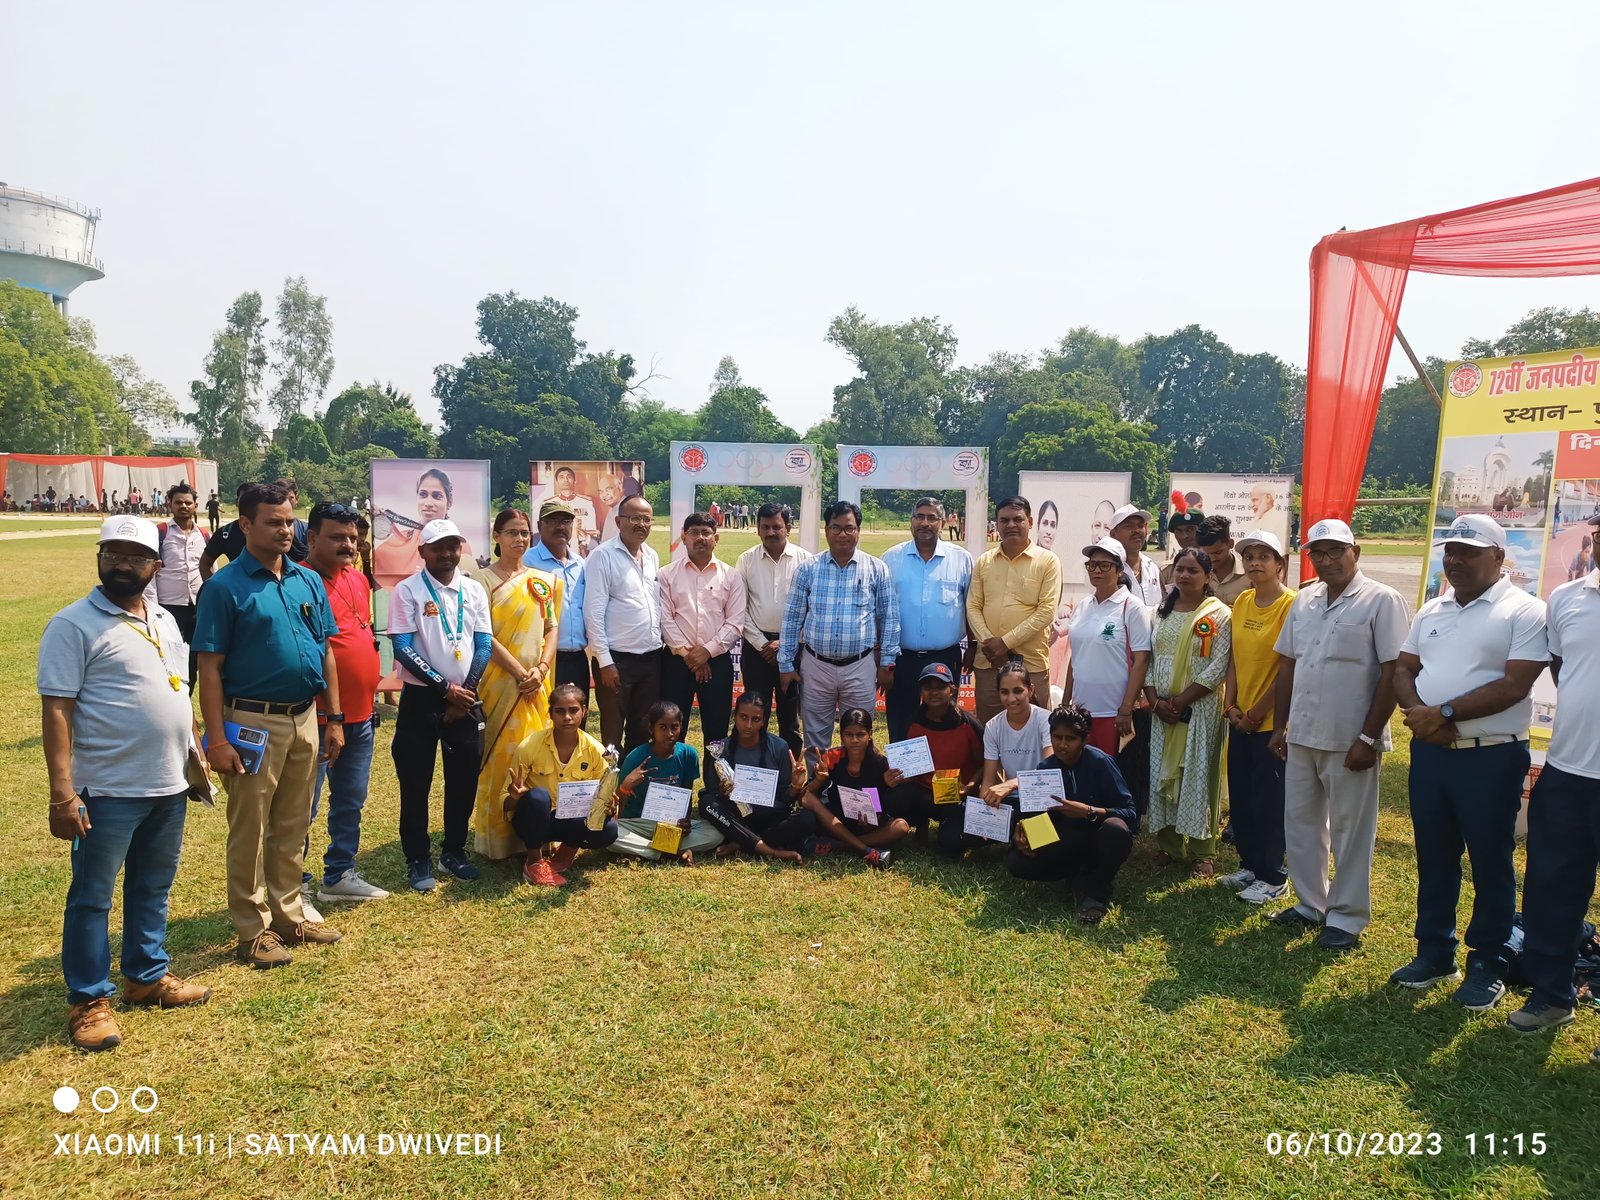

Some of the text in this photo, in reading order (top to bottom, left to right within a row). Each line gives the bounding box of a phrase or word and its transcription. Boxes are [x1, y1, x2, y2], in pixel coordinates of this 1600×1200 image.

[402, 646, 444, 683] SPORTS
[706, 805, 731, 826] Calvin Klein
